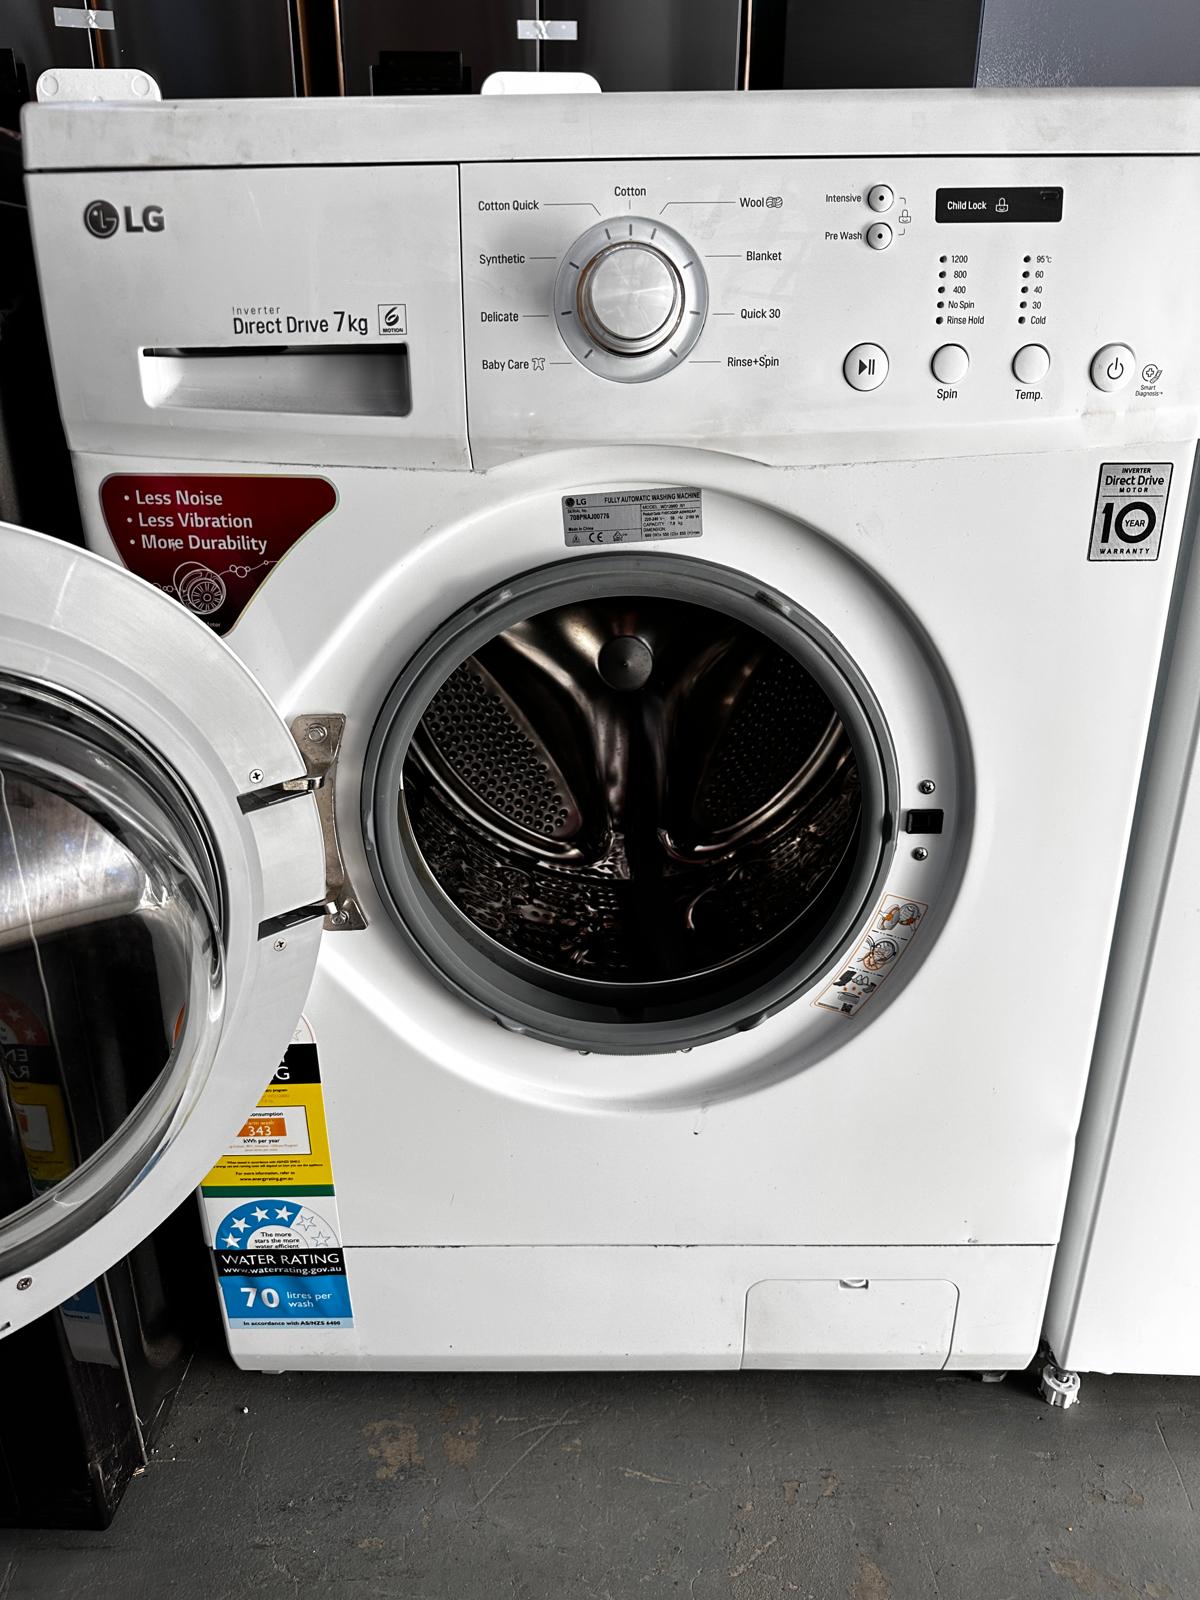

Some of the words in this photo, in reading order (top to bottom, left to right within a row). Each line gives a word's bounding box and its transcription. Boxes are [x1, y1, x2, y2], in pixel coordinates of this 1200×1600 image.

[614, 186, 647, 197] Cotton
[740, 198, 765, 208] Wool
[825, 194, 862, 203] Intensive
[478, 201, 511, 211] Cotton
[512, 200, 539, 211] Quick
[947, 201, 967, 210] Child
[968, 201, 987, 210] Lock
[124, 205, 165, 233] LG
[825, 232, 838, 240] Pre
[840, 232, 862, 241] Wash
[479, 254, 526, 266] Synthetic
[746, 251, 782, 261] Blanket
[951, 255, 968, 263] 1200
[953, 270, 967, 279] 800
[1035, 270, 1044, 278] 60
[232, 306, 281, 315] Inverter
[960, 301, 975, 310] Spin
[480, 311, 519, 322] Delicate
[740, 309, 767, 319] Quick
[769, 308, 781, 318] 30
[233, 317, 282, 334] Direct
[287, 316, 329, 333] Drive
[947, 316, 966, 325] Rinse
[968, 316, 985, 325] Hold
[1030, 316, 1046, 325] Cold
[482, 360, 505, 371] Baby
[508, 360, 529, 370] Care
[727, 357, 779, 369] Rinse+Spin
[936, 388, 958, 401] Spin
[1015, 389, 1043, 402] Temp.
[1105, 475, 1136, 486] Direct
[1137, 475, 1165, 486] Drive
[135, 490, 172, 505] Less
[175, 490, 223, 506] Noise
[652, 493, 675, 501] WASHING
[677, 491, 700, 499] MACHINE
[138, 512, 174, 528] Less
[177, 512, 253, 529] Vibration
[1101, 501, 1157, 544] 10
[1125, 519, 1146, 528] YEAR
[141, 534, 184, 550] More
[188, 535, 268, 555] Durability
[248, 1126, 272, 1137] 343
[222, 1254, 277, 1266] WATER
[280, 1252, 340, 1265] RATING
[223, 1265, 343, 1276] www.waterrating.gov.au
[240, 1286, 280, 1309] 70
[286, 1291, 313, 1300] litres
[314, 1293, 333, 1302] per
